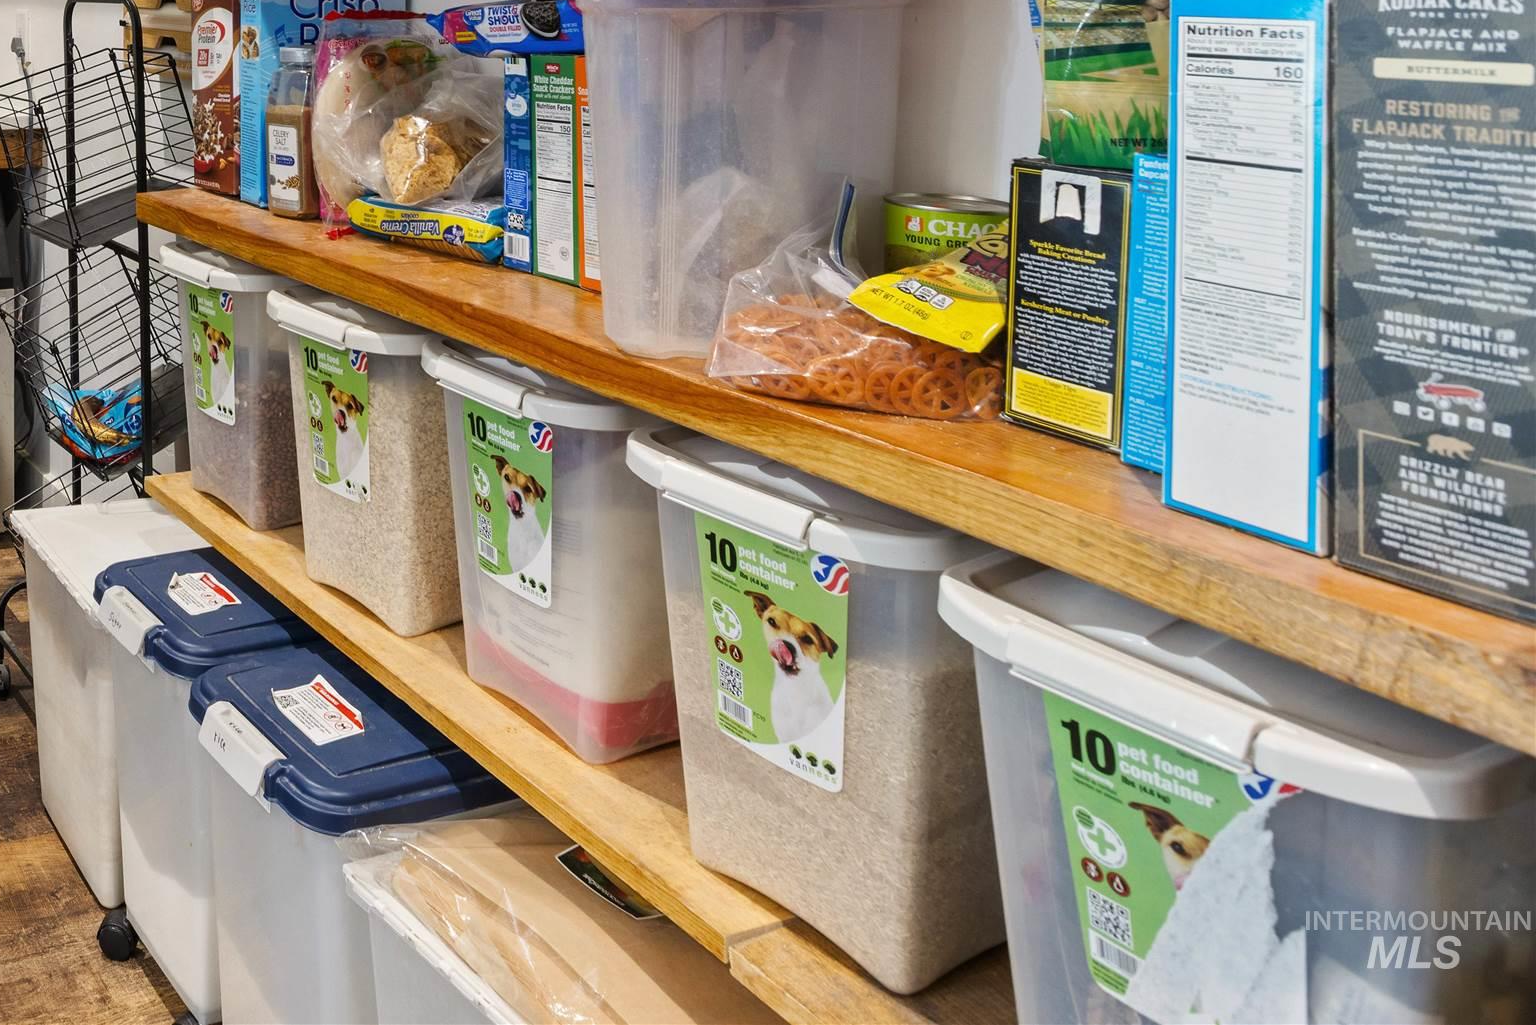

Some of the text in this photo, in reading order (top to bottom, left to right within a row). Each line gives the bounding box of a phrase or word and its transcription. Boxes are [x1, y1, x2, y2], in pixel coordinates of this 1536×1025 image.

[243, 0, 256, 13] Rice
[465, 8, 482, 17] Great
[488, 6, 510, 16] TWIST
[488, 15, 521, 26] SHOUT
[1409, 11, 1445, 19] PARK
[197, 24, 218, 35] Premier
[1187, 24, 1305, 40] Nutrition Facts
[1386, 26, 1520, 41] FLAPJACK AND
[197, 33, 217, 44] Protein
[1397, 39, 1507, 53] WAFFLE MIX
[1186, 63, 1304, 79] Calories 160
[1407, 65, 1497, 77] BUTTERMILK
[533, 75, 574, 85] White Cheddar
[532, 83, 575, 95] Snack Crackers
[537, 102, 571, 111] Nutrition Facts
[1385, 99, 1493, 122] RESTORING
[272, 129, 289, 137] CELERY
[559, 125, 571, 133] 150
[1352, 118, 1445, 141] FLAPJACK
[275, 137, 287, 146] SALT
[381, 219, 441, 236] Vanilla Creme
[905, 233, 941, 247] YOUNG
[1028, 239, 1106, 260] Sparkle Favorite Bread
[1037, 248, 1062, 259] Baking
[189, 292, 199, 314] 10
[871, 287, 914, 312] NET WT 1.7 OZ
[1021, 298, 1054, 313] Koshering
[1054, 305, 1072, 316] Meat
[1082, 311, 1110, 326] Poultry
[1383, 309, 1493, 339] NOURISHMENT
[1376, 321, 1437, 345] TODAY'S
[304, 345, 318, 371] 10
[325, 353, 339, 365] food
[468, 411, 515, 443] 10 pet food
[487, 431, 521, 452] container
[1399, 454, 1506, 491] GRIZZLY BEAR
[1398, 467, 1507, 505] AND WILDLIFE
[1401, 480, 1504, 517] FOUNDATIONS
[705, 531, 787, 574] 10 pet food
[738, 559, 796, 591] container
[1060, 718, 1200, 786] 10 pet food
[1117, 758, 1215, 810] container
